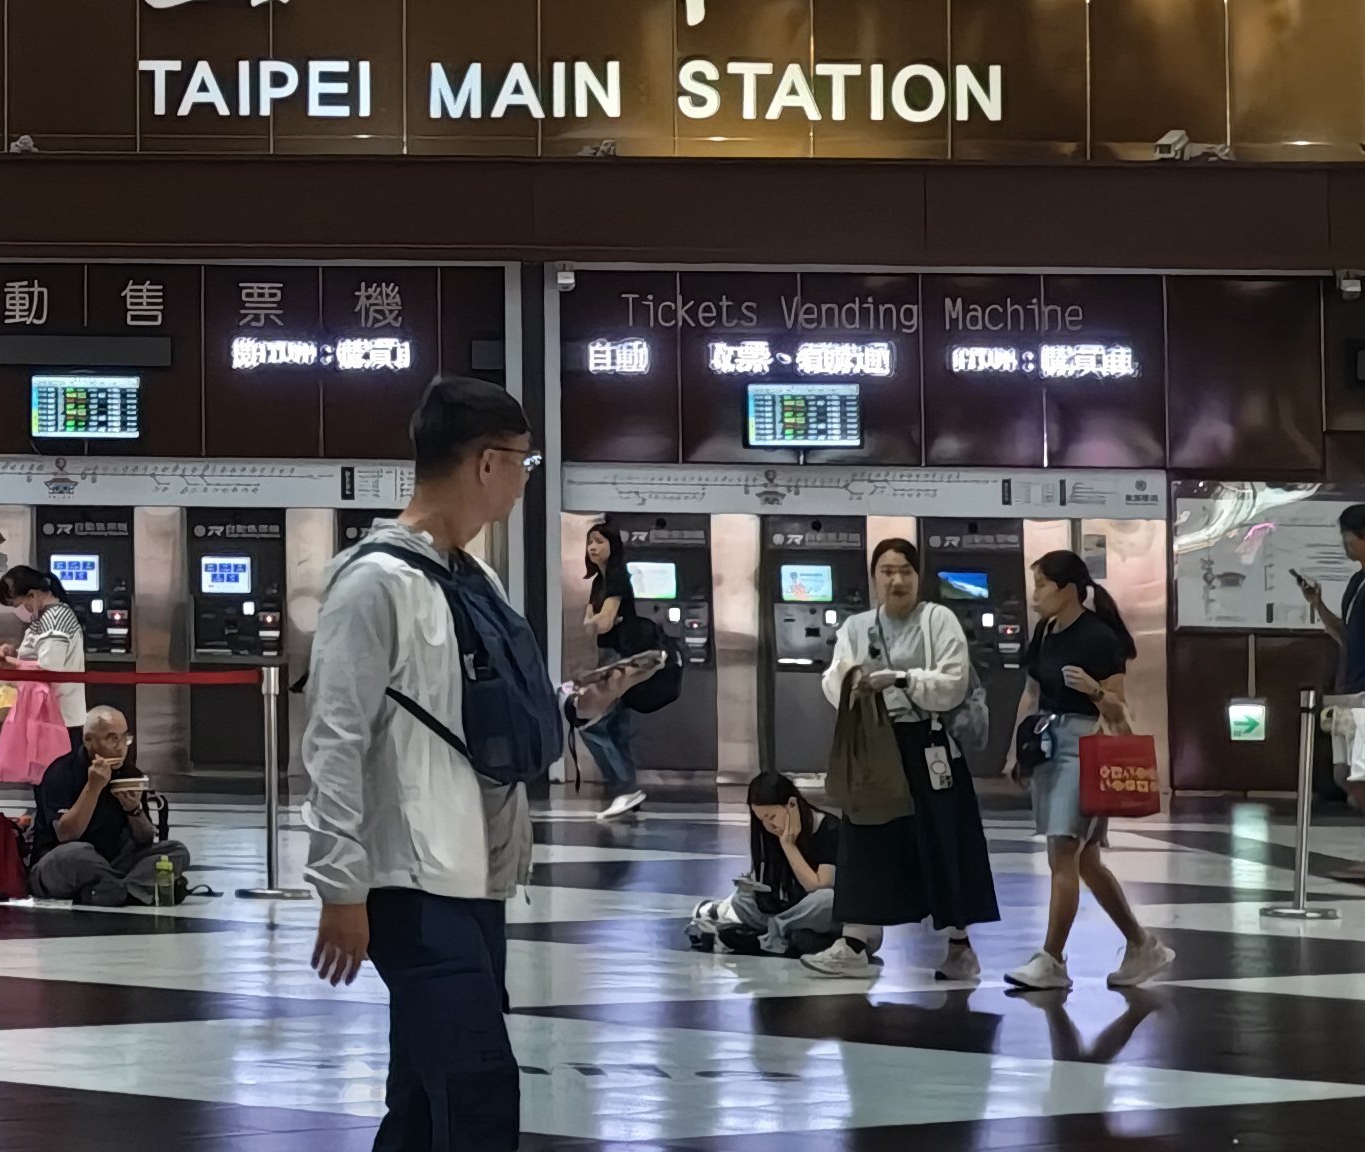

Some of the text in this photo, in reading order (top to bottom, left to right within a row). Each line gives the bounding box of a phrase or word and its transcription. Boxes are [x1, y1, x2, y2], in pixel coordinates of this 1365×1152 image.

[138, 59, 1002, 123] TAIPEI MAIN STATION
[621, 293, 1084, 334] Tickets Vending Machine
